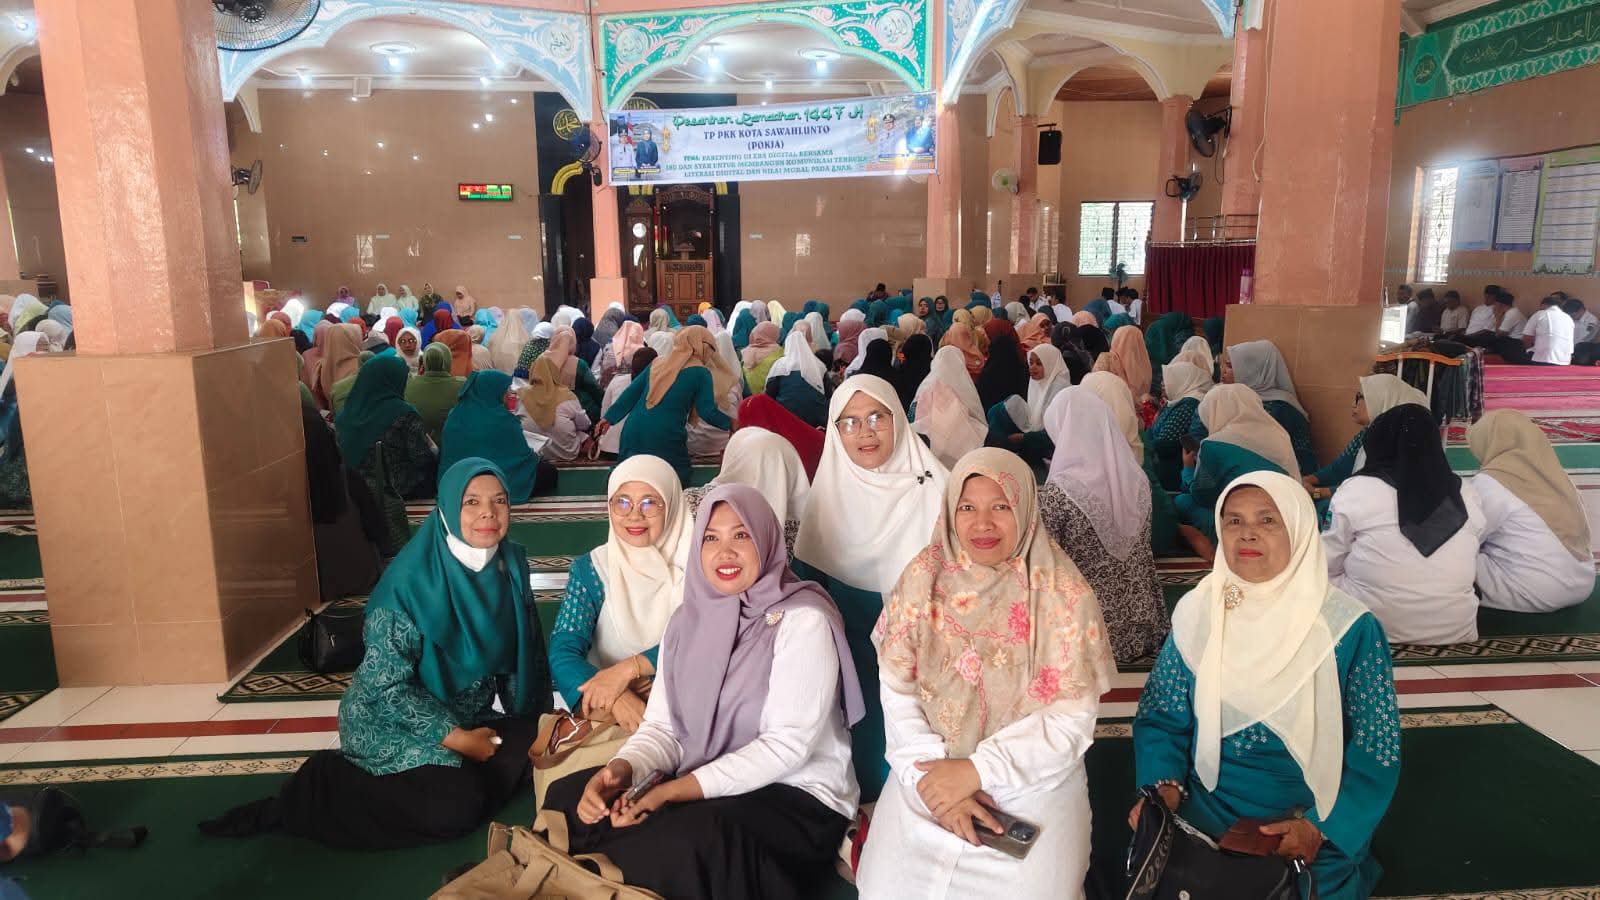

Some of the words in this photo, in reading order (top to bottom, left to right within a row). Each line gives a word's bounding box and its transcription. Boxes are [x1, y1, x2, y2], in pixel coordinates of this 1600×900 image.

[804, 105, 846, 122] 1447
[704, 131, 716, 140] TP
[717, 129, 736, 139] PKK
[739, 127, 763, 138] KOTA
[764, 125, 830, 137] SAWAHLUNTO
[799, 149, 833, 157] BERSAMA
